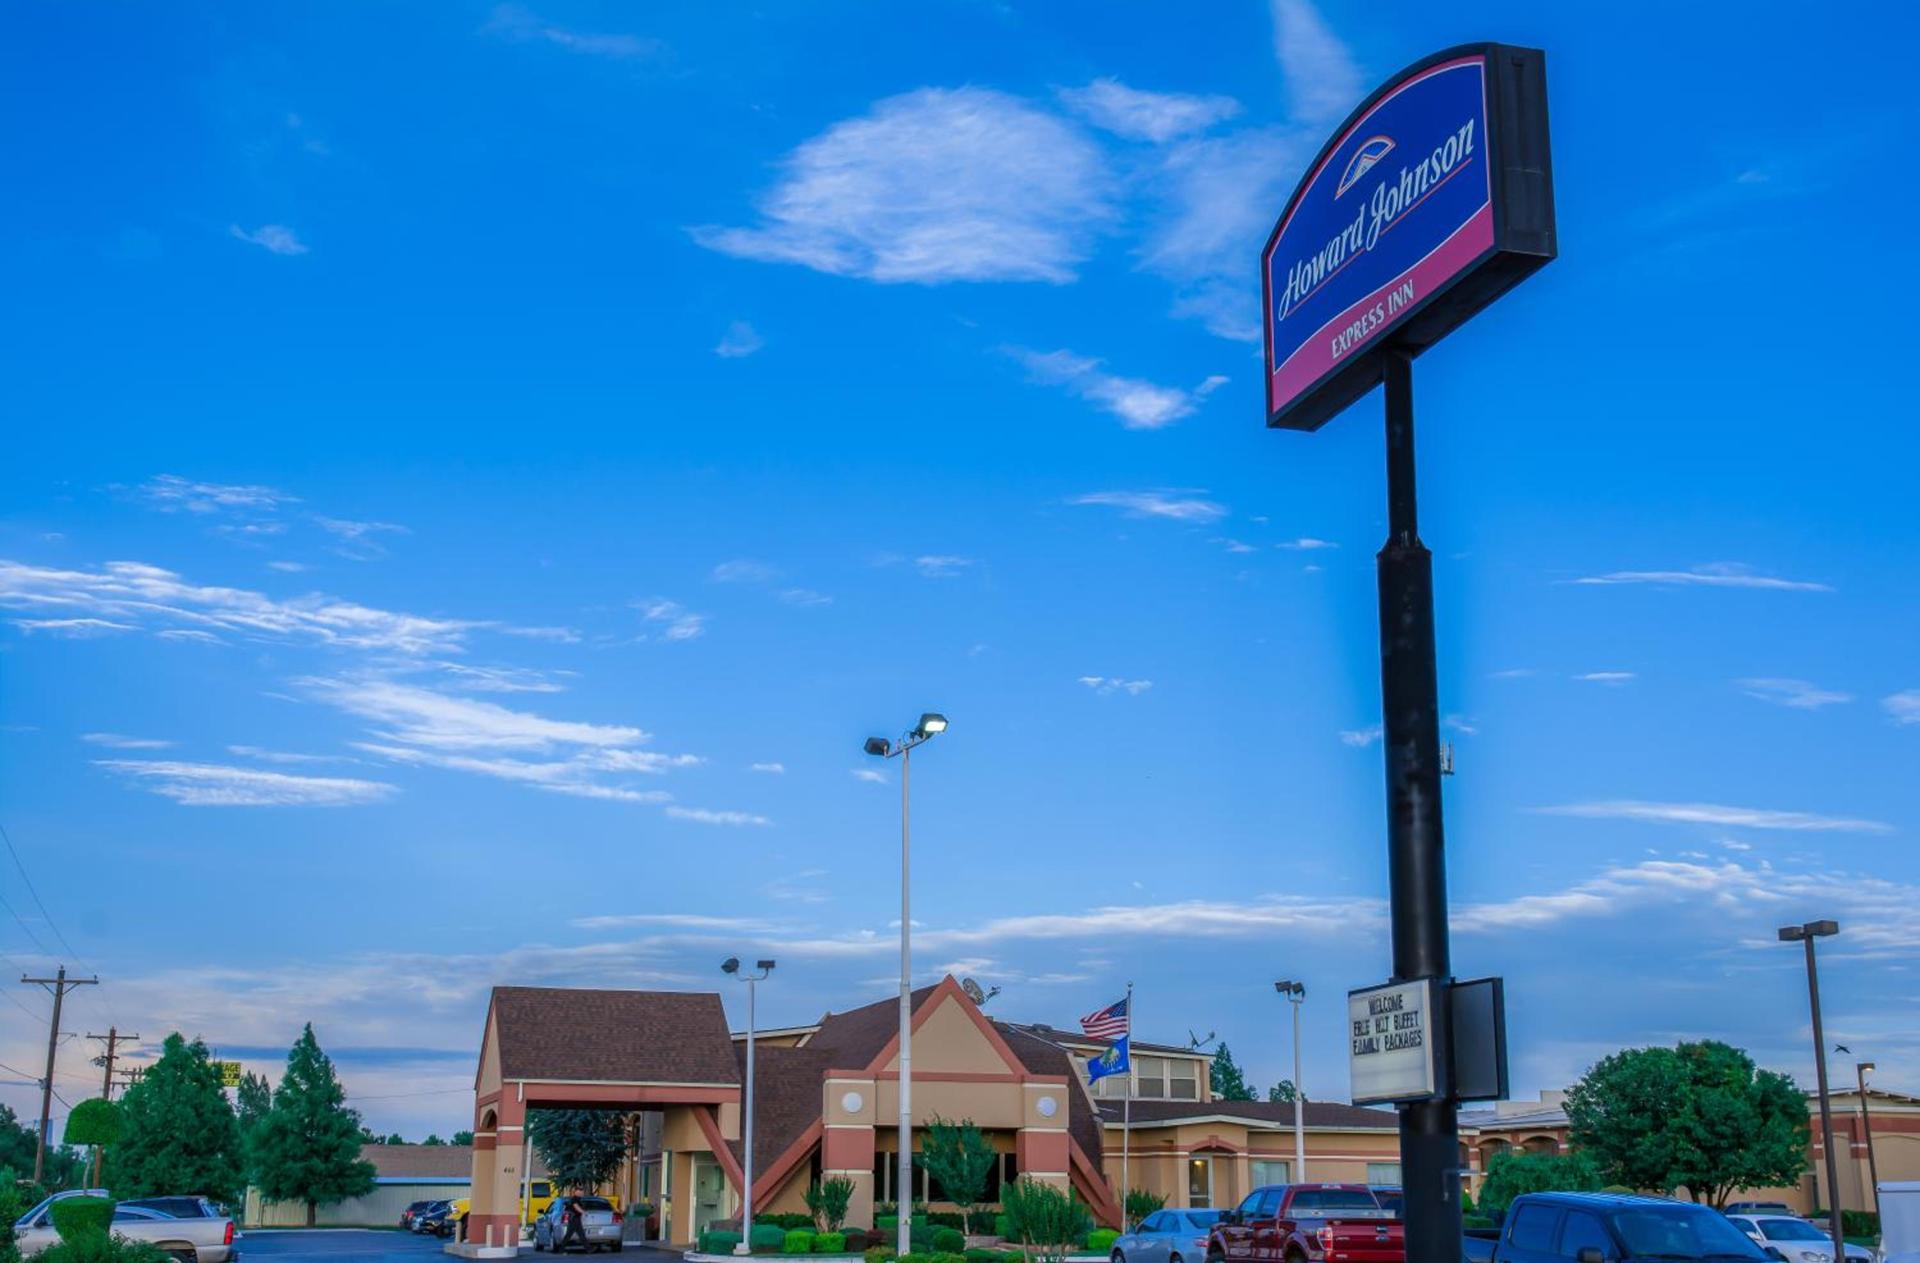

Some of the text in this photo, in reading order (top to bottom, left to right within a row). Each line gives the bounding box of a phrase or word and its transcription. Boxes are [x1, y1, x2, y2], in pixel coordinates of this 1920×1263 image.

[1279, 118, 1474, 321] Howard Johnson
[1331, 280, 1415, 360] EXPRESS INN
[1368, 994, 1403, 1015] WELCOME
[1394, 1011, 1419, 1030] BUFFET
[1353, 1030, 1422, 1056] FAMILY PACKAGES
